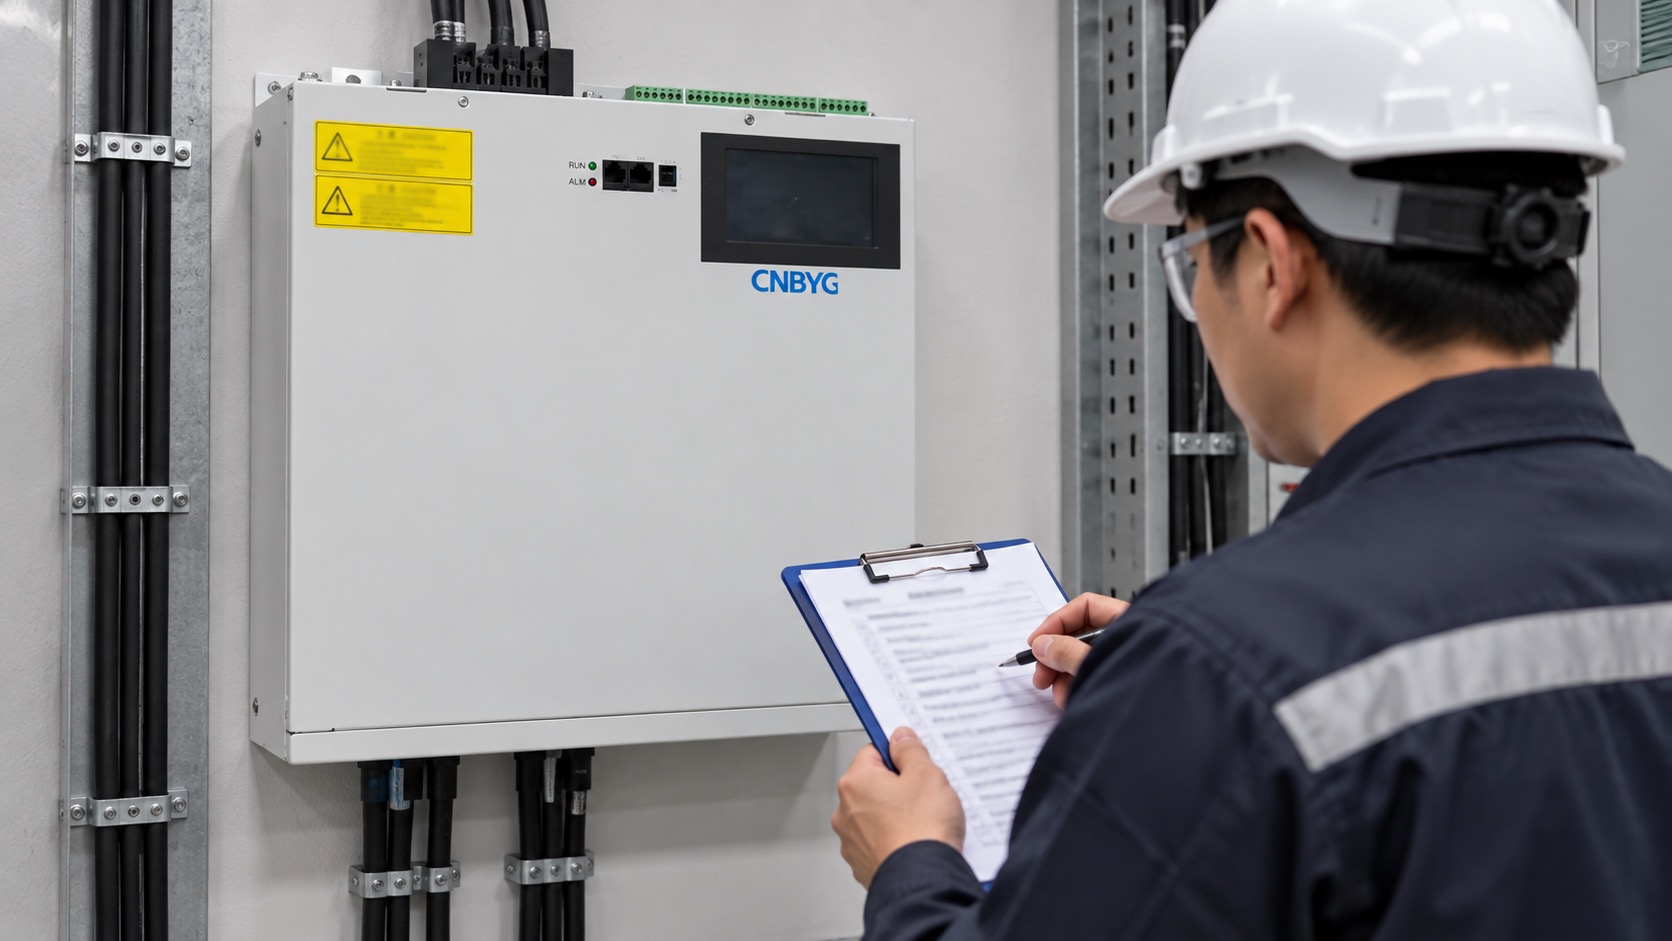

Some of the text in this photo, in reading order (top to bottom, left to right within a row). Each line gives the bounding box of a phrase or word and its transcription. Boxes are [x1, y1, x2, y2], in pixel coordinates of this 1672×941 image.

[568, 161, 585, 169] RUN
[568, 178, 586, 186] ALM
[751, 269, 839, 295] CNBYG
